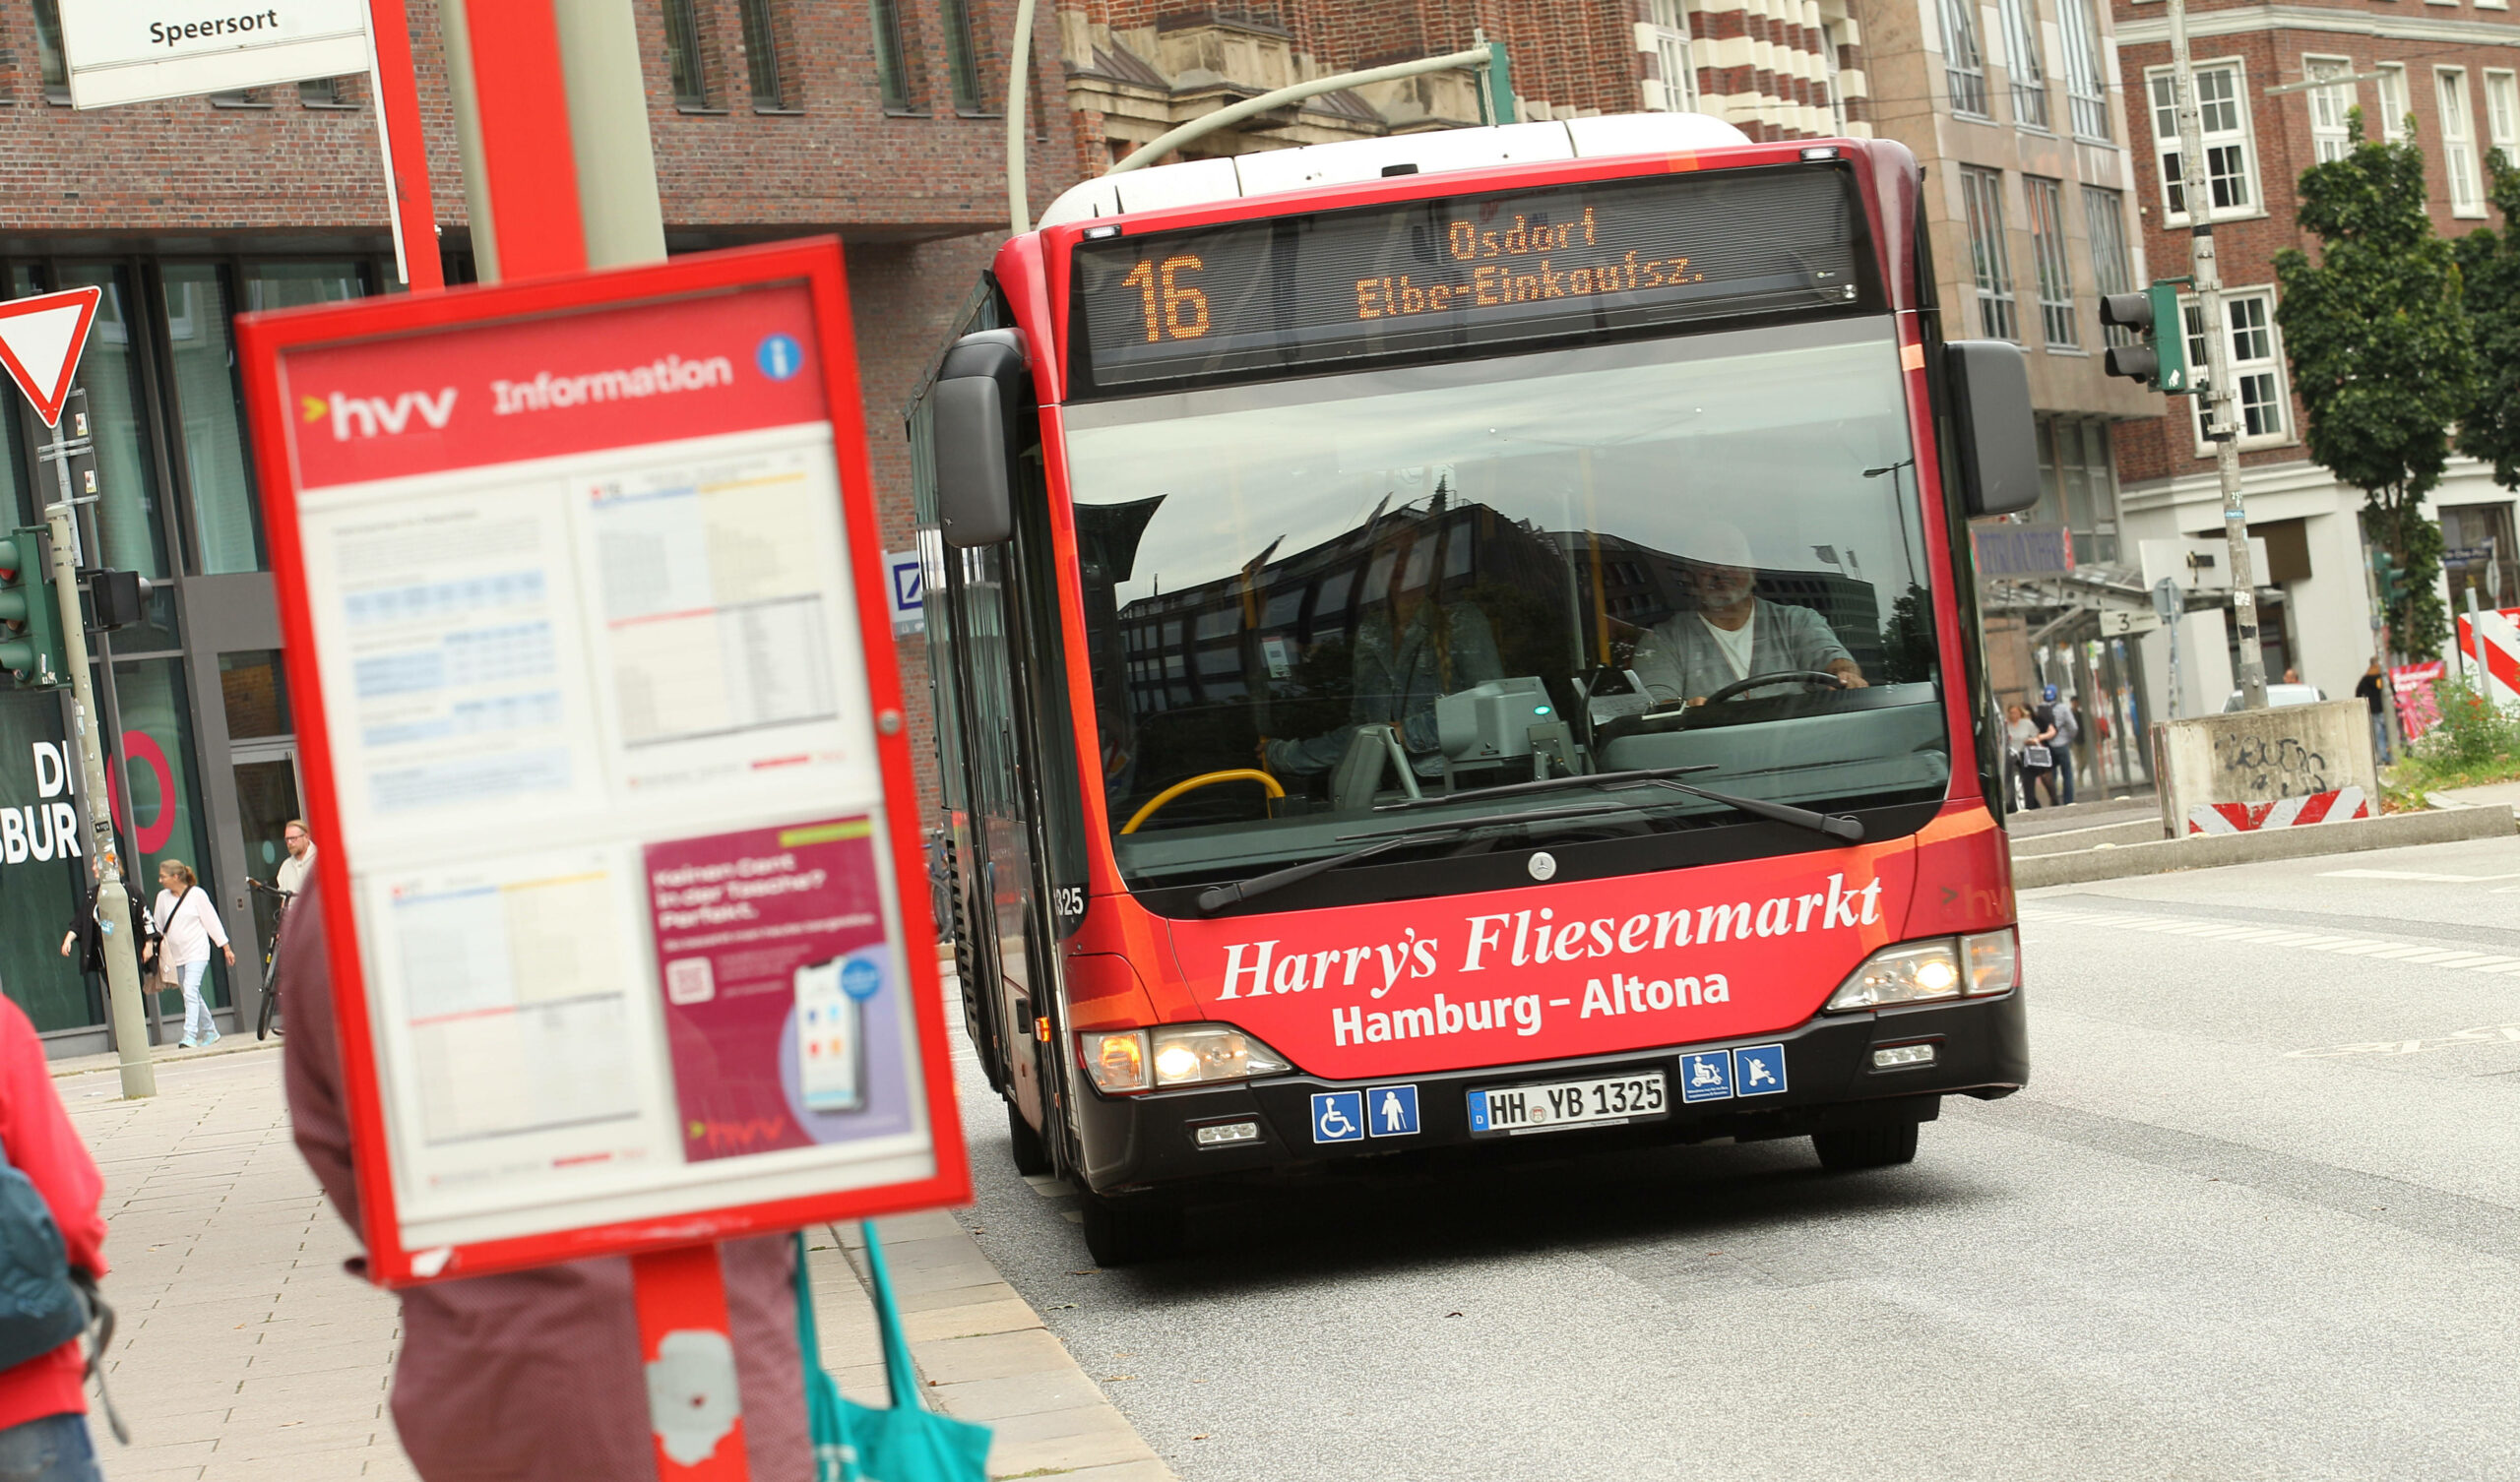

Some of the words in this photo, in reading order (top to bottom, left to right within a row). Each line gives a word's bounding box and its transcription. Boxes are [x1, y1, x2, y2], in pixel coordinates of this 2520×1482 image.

[150, 9, 279, 47] Speersort
[1121, 253, 1211, 342] 16
[1355, 249, 1706, 320] Elbe-Einkaufsz.
[329, 387, 460, 443] hvv
[490, 352, 734, 416] Information
[2117, 613, 2131, 632] 3
[0, 801, 83, 865] BUR
[1215, 926, 1438, 1001] Harry's
[1458, 872, 1883, 972] Fliesenmarkt
[1331, 992, 1543, 1047] Hamburg
[1579, 972, 1731, 1020] Altona
[1476, 1115, 1484, 1125] D
[1488, 1091, 1527, 1126] HH
[1546, 1086, 1584, 1120] YB
[1592, 1079, 1664, 1115] 1325
